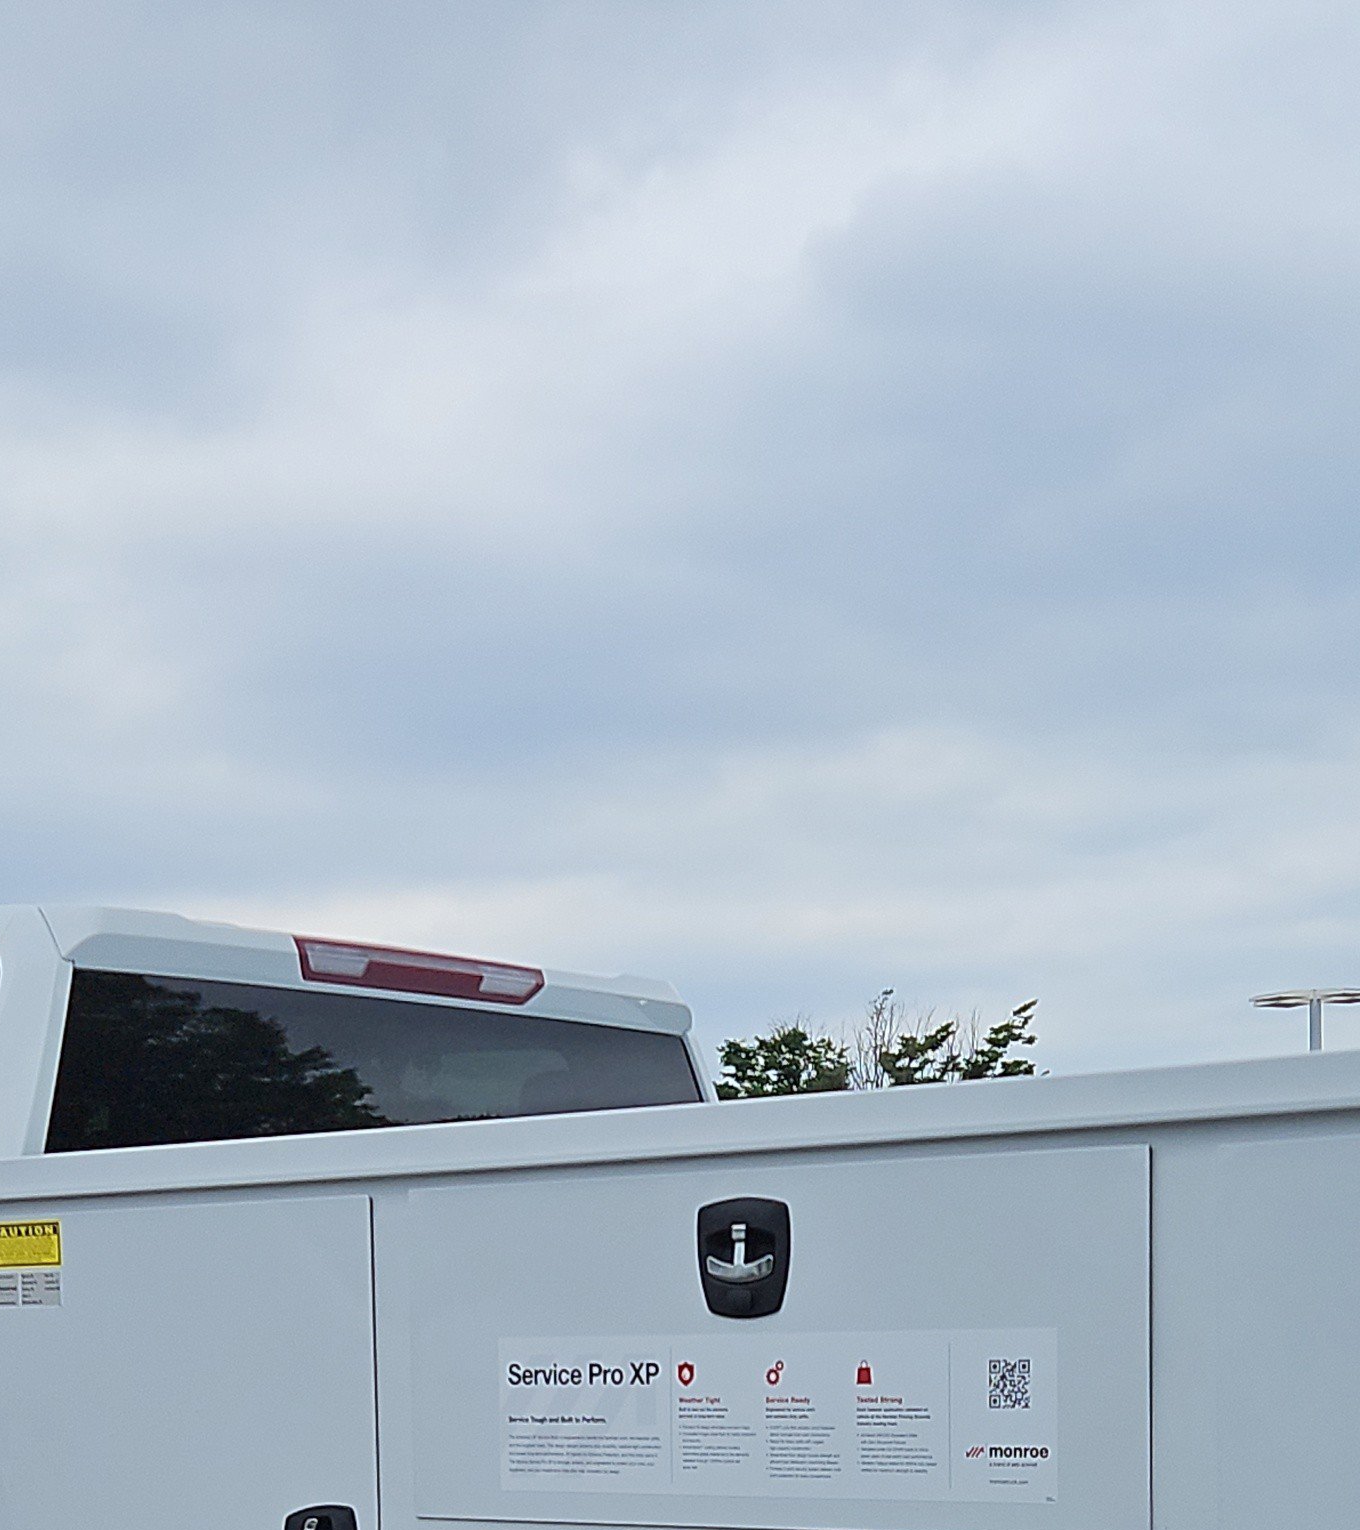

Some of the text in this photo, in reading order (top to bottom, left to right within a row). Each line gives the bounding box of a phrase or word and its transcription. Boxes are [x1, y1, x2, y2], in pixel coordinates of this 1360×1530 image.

[508, 1361, 660, 1386] Service Pro XP
[988, 1445, 1049, 1459] monroe
